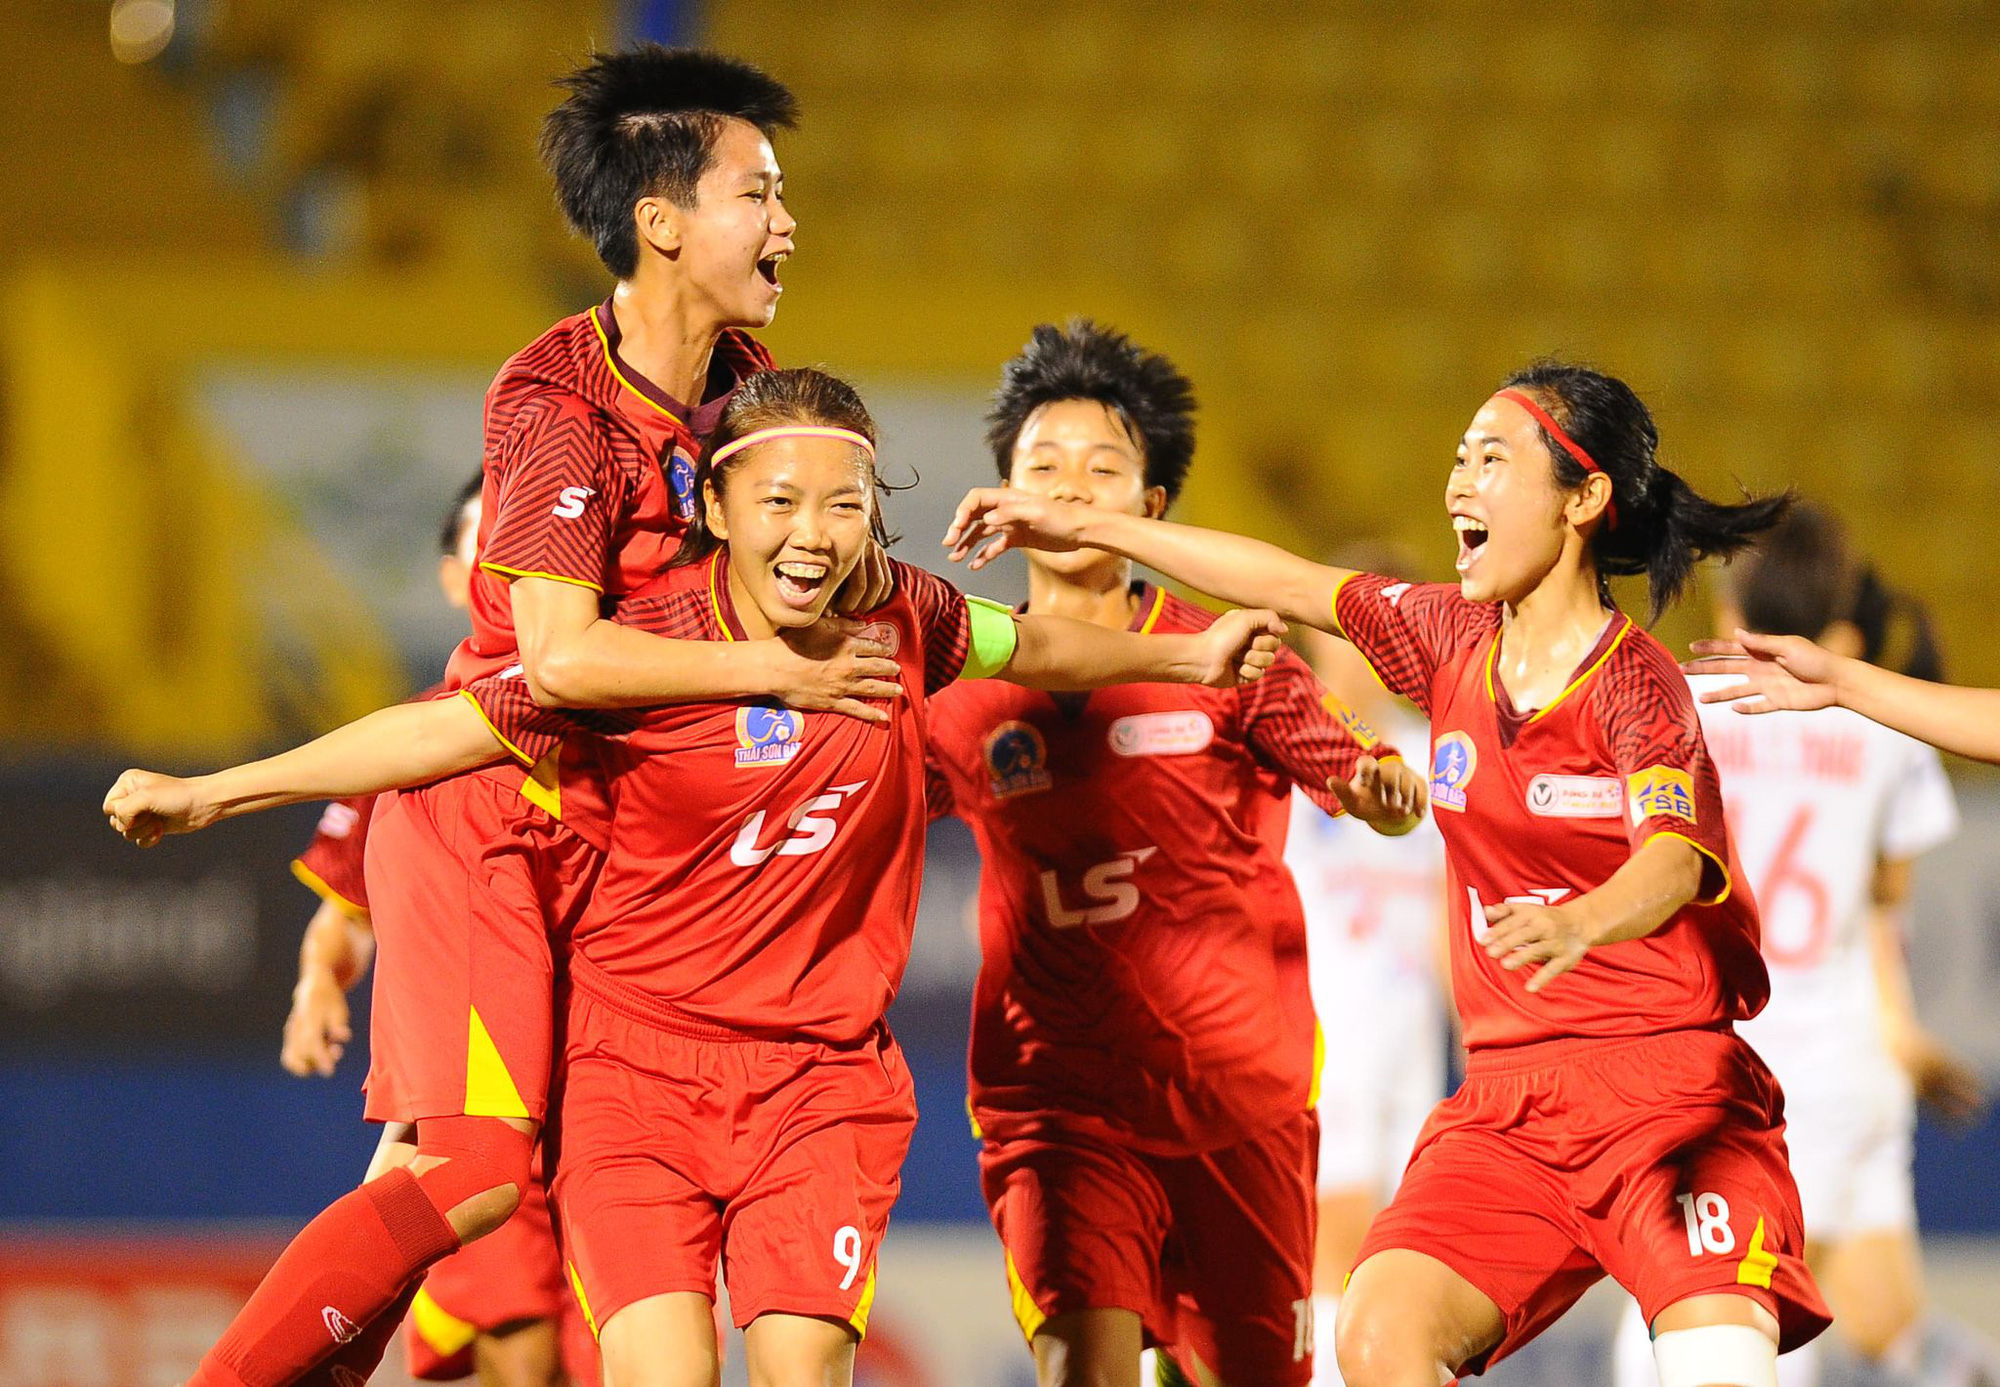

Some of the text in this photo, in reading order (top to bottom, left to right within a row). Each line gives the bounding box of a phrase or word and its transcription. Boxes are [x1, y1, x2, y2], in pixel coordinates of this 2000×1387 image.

[552, 486, 588, 519] S
[730, 793, 843, 867] LS
[1041, 858, 1140, 928] LS
[1676, 1191, 1735, 1257] 18
[833, 1226, 861, 1290] 9
